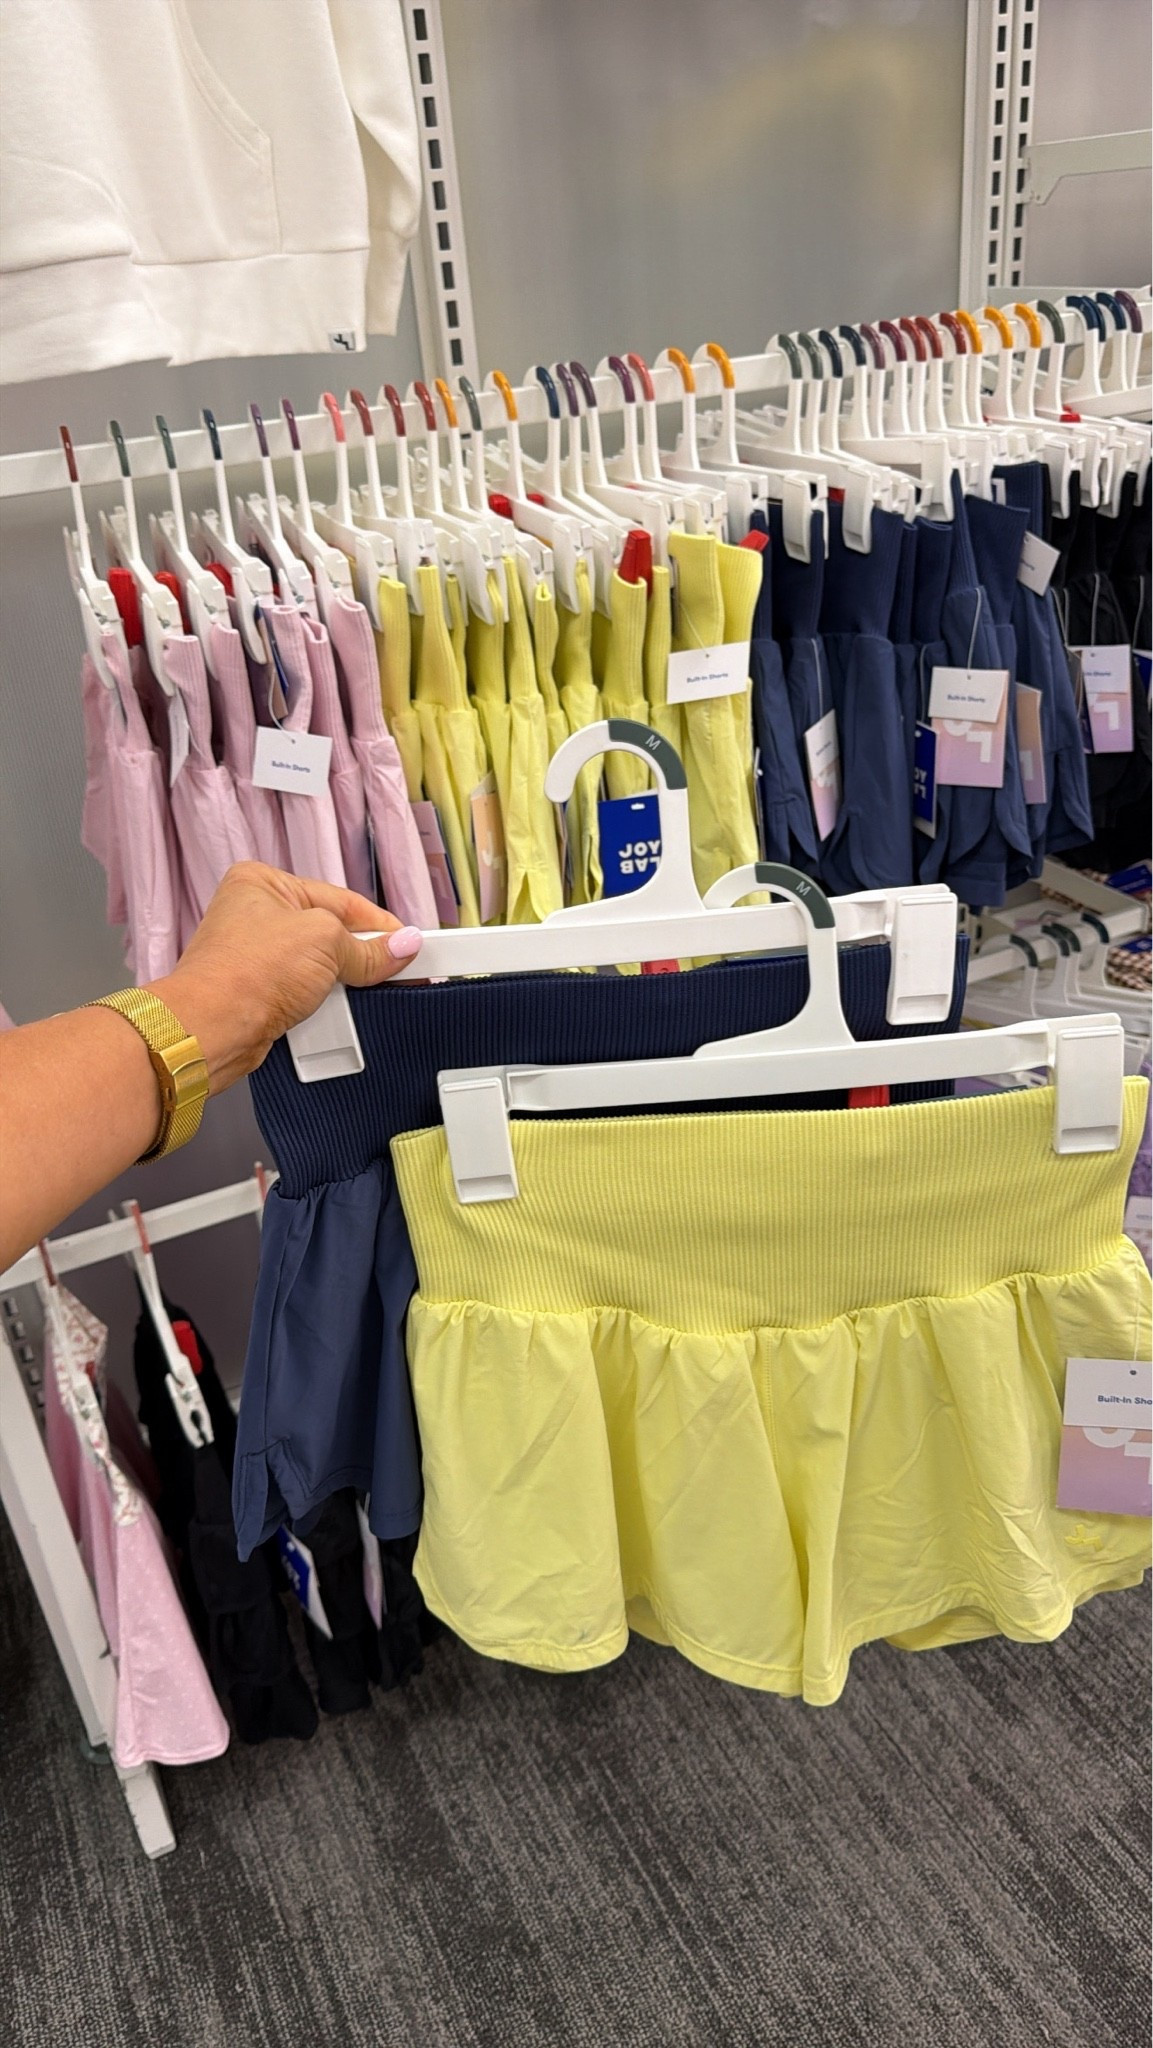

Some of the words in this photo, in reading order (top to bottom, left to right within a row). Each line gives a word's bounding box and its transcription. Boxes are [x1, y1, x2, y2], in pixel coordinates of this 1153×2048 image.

[709, 672, 729, 680] Shorts
[967, 695, 986, 703] Shorts
[645, 734, 662, 750] M
[292, 764, 311, 773] Shorts
[618, 840, 661, 858] JOY
[795, 880, 812, 896] M
[1097, 1394, 1132, 1403] Built-In
